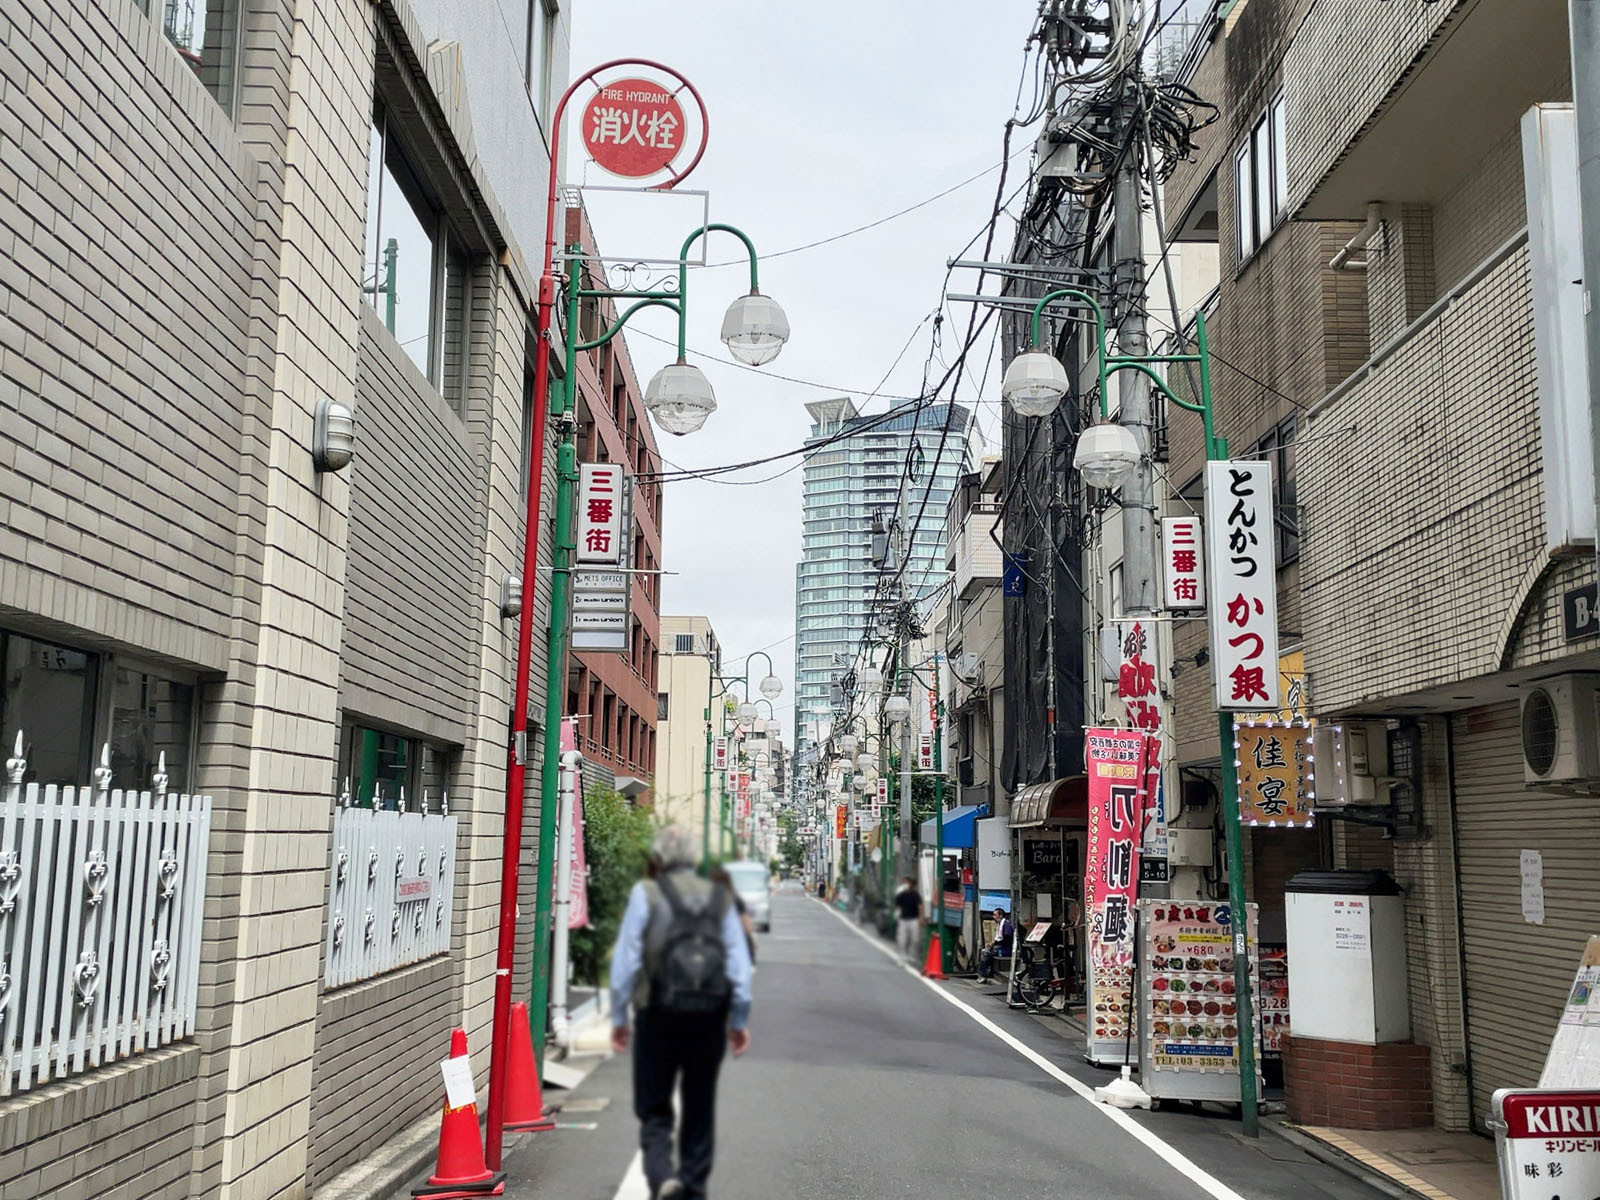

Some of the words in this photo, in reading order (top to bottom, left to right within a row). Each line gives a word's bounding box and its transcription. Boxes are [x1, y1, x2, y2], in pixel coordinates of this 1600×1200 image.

[591, 106, 678, 149] 消火栓
[602, 89, 623, 101] FIRE
[626, 91, 671, 104] HYDRANT
[586, 471, 613, 552] 三番街
[1227, 469, 1258, 578] とんかつ
[1172, 524, 1197, 600] 三番街
[1227, 593, 1269, 702] かつ銀
[921, 736, 931, 767] 三番街
[1252, 736, 1288, 815] 佳宴
[1524, 1162, 1563, 1178] 味彩
